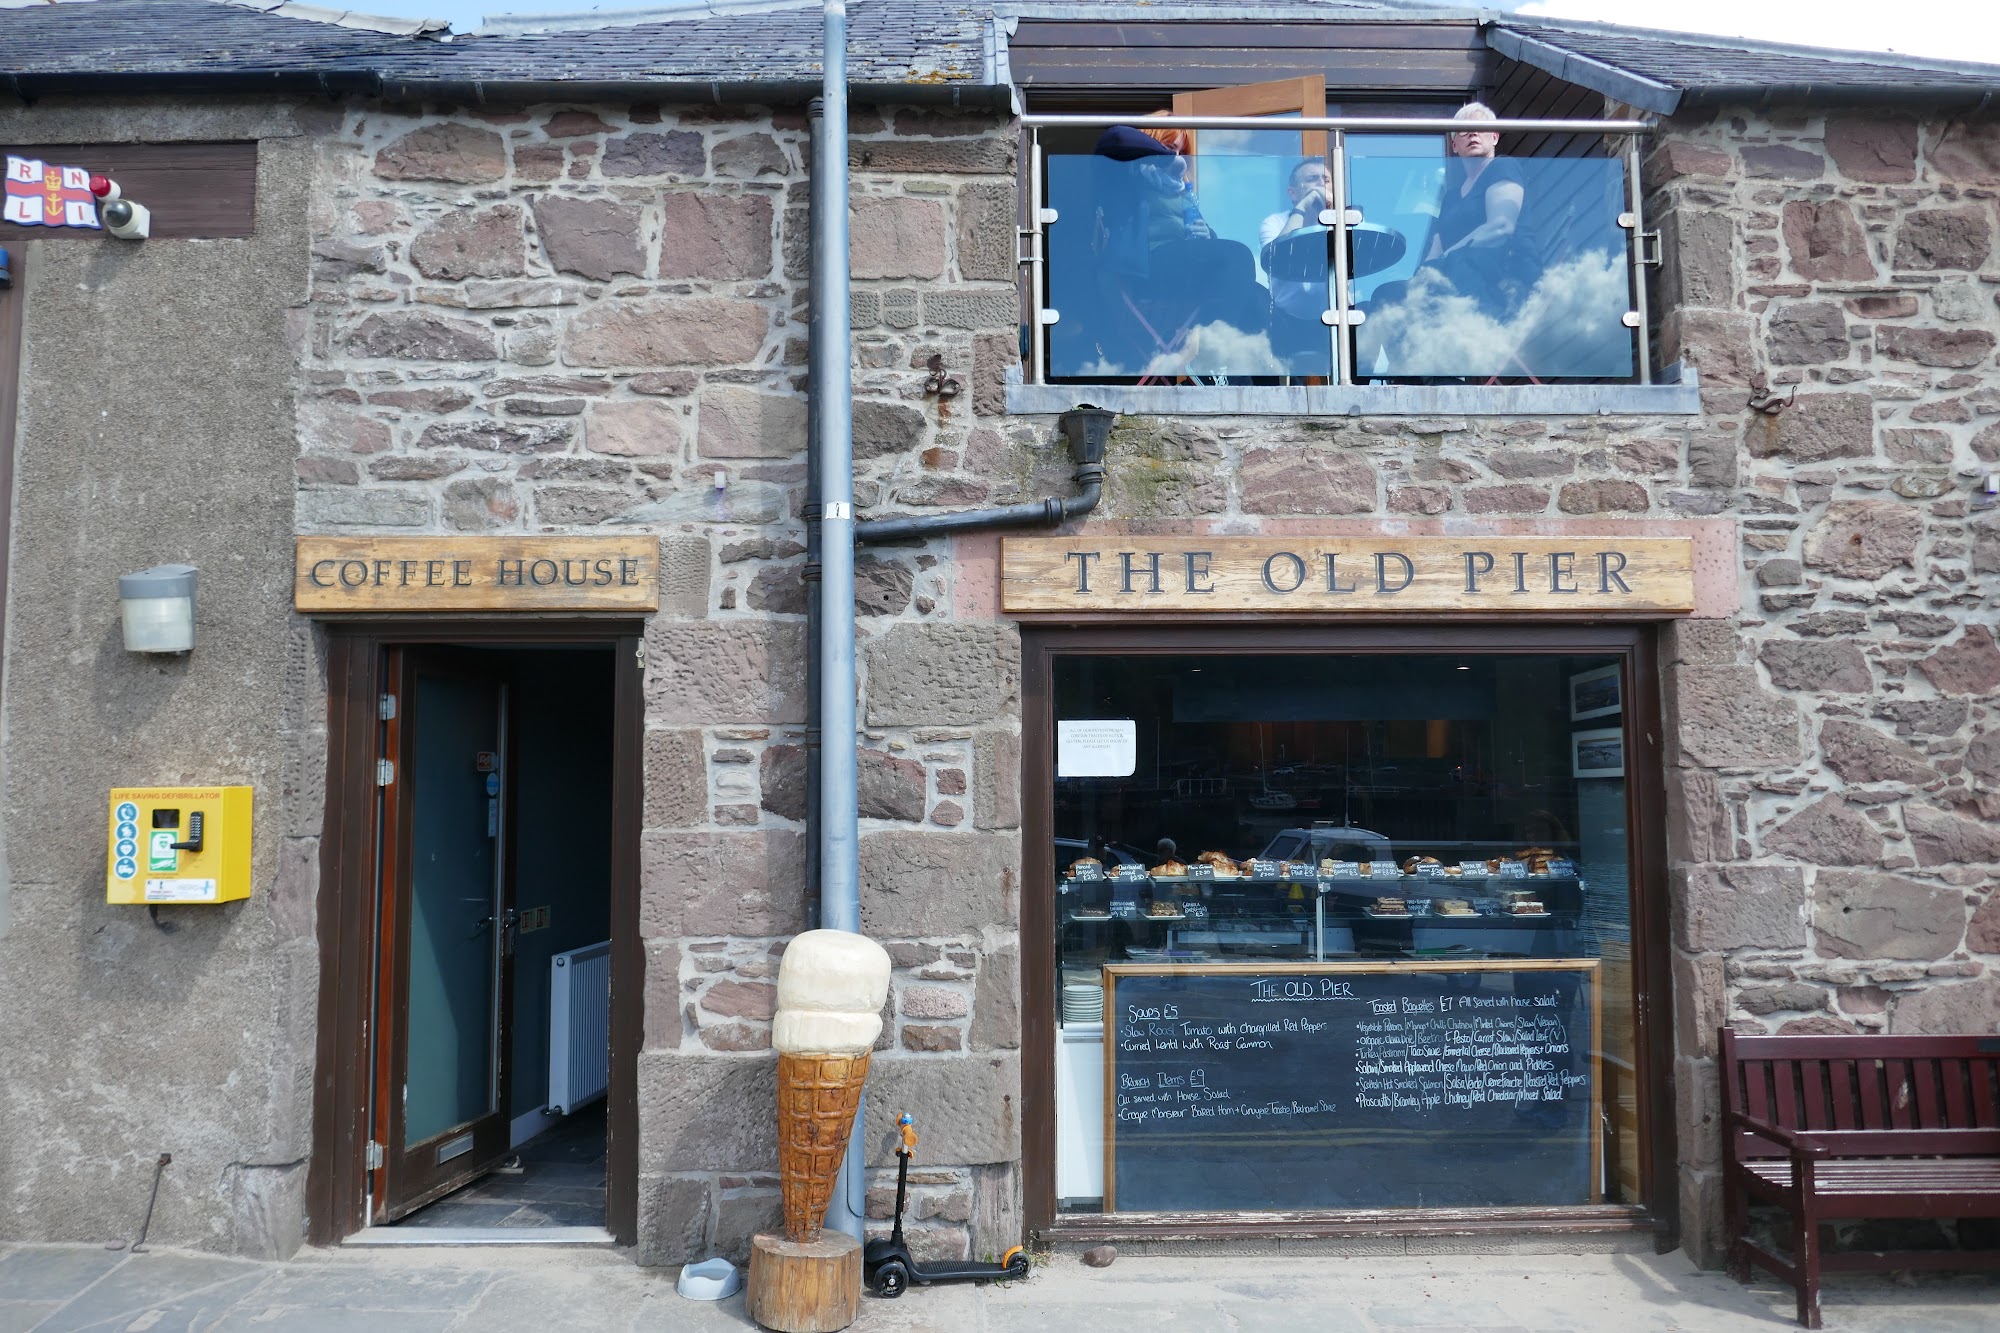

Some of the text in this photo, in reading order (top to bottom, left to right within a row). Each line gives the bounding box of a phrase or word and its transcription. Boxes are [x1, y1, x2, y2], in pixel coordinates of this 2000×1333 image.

[310, 559, 640, 588] COFFEE HOUSE
[1064, 552, 1633, 597] THE OLD PIER
[114, 792, 220, 800] LIFE SAVING DEFIBRILLATOR
[1250, 978, 1354, 998] THE OLD PIER
[1164, 1003, 1179, 1019] £5
[1366, 998, 1397, 1014] Toasted
[1402, 996, 1435, 1016] Baguettes
[1459, 995, 1471, 1008] All
[1124, 1024, 1145, 1038] Slow
[1180, 1021, 1213, 1036] Tomato
[1218, 1022, 1236, 1035] with
[1284, 1018, 1299, 1032] Red
[1301, 1017, 1328, 1034] Peppers
[1124, 1038, 1151, 1053] Curried
[1206, 1035, 1232, 1050] Roast
[1545, 1042, 1569, 1054] Onions
[1487, 1060, 1506, 1071] Onion
[1190, 1069, 1205, 1087] £9
[1383, 1077, 1393, 1090] Hot
[1394, 1078, 1418, 1090] Smoked
[1559, 1069, 1586, 1088] Peppers
[1157, 1091, 1173, 1102] with
[1203, 1086, 1230, 1101] Salad
[1421, 1091, 1441, 1110] Apple
[1542, 1085, 1563, 1102] Salad
[1151, 1106, 1188, 1119] Monsieur
[1217, 1104, 1235, 1115] Ham
